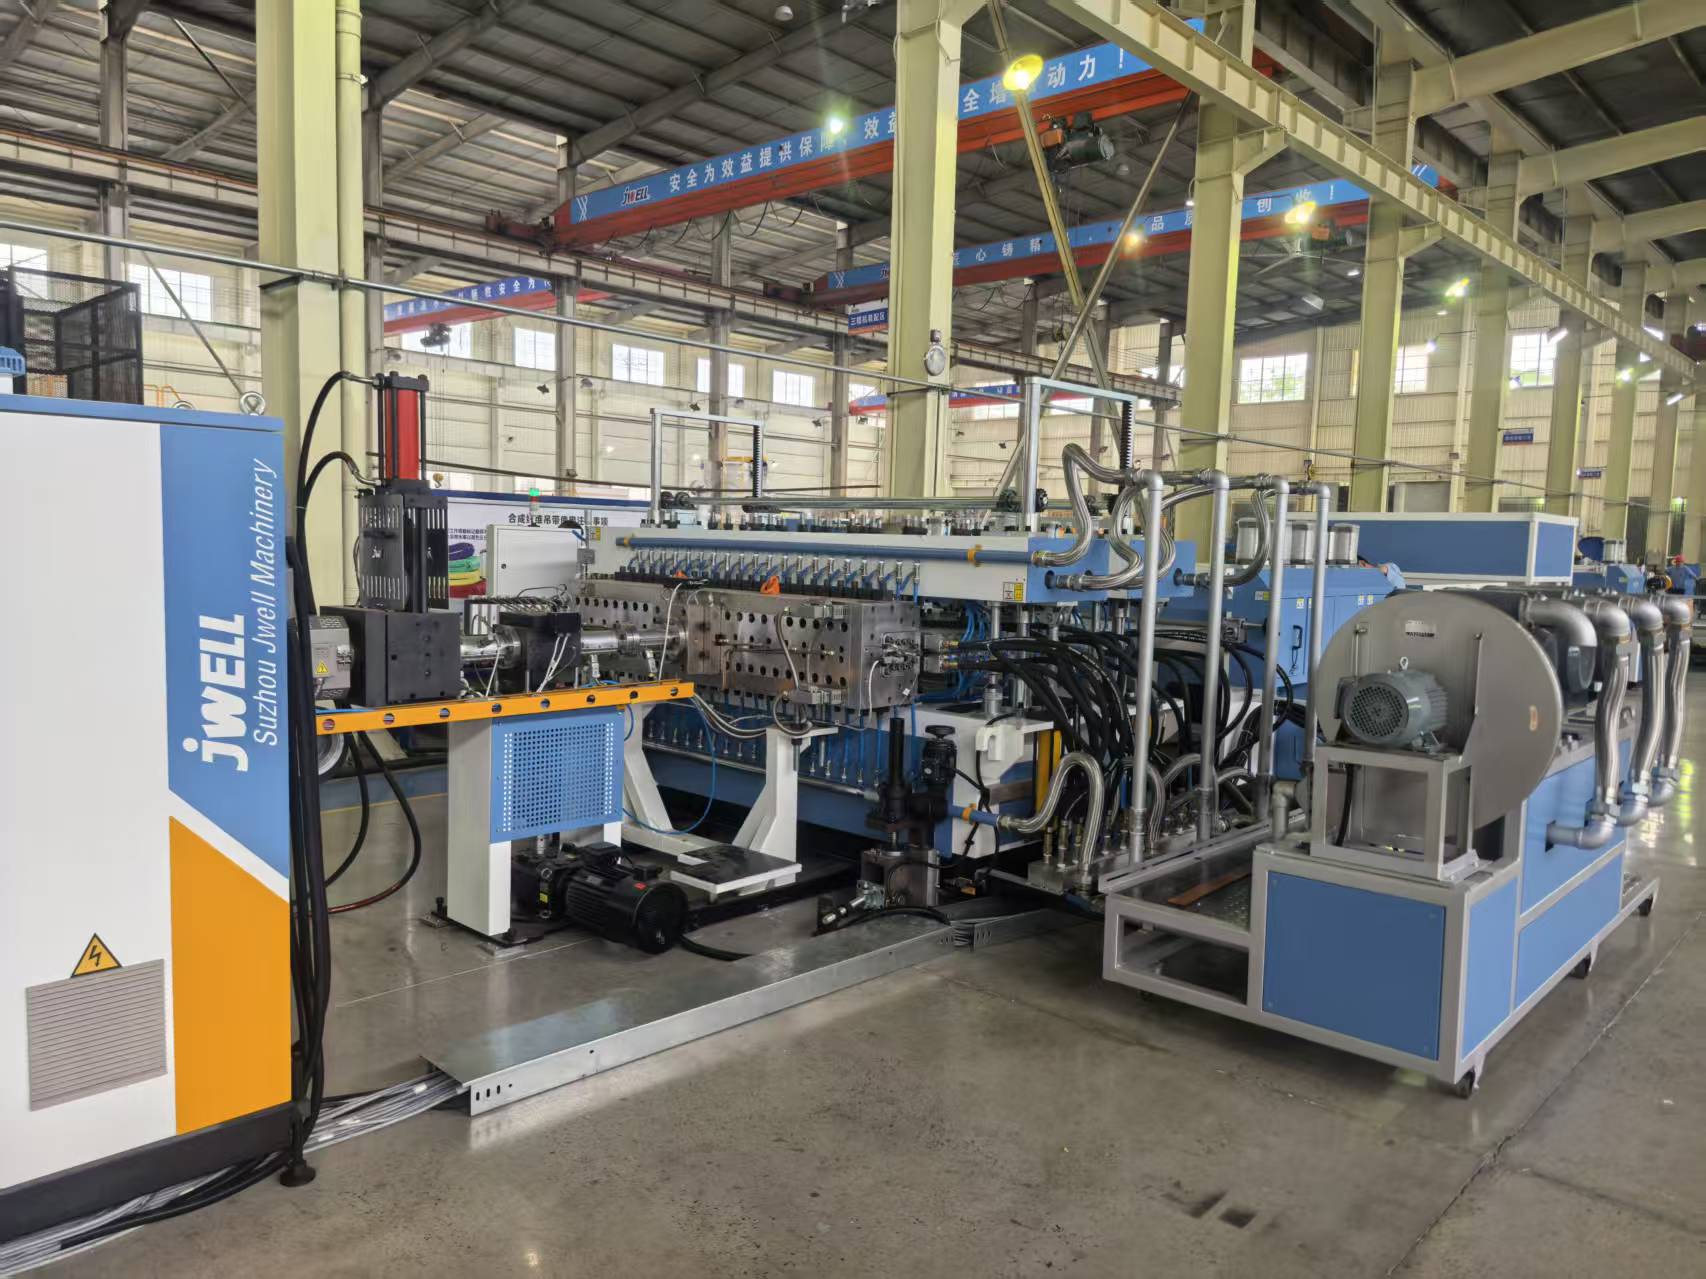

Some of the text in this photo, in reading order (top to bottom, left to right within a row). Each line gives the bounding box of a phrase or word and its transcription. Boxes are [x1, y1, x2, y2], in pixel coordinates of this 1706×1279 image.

[249, 457, 278, 746] Suzhou Jwell Machinery
